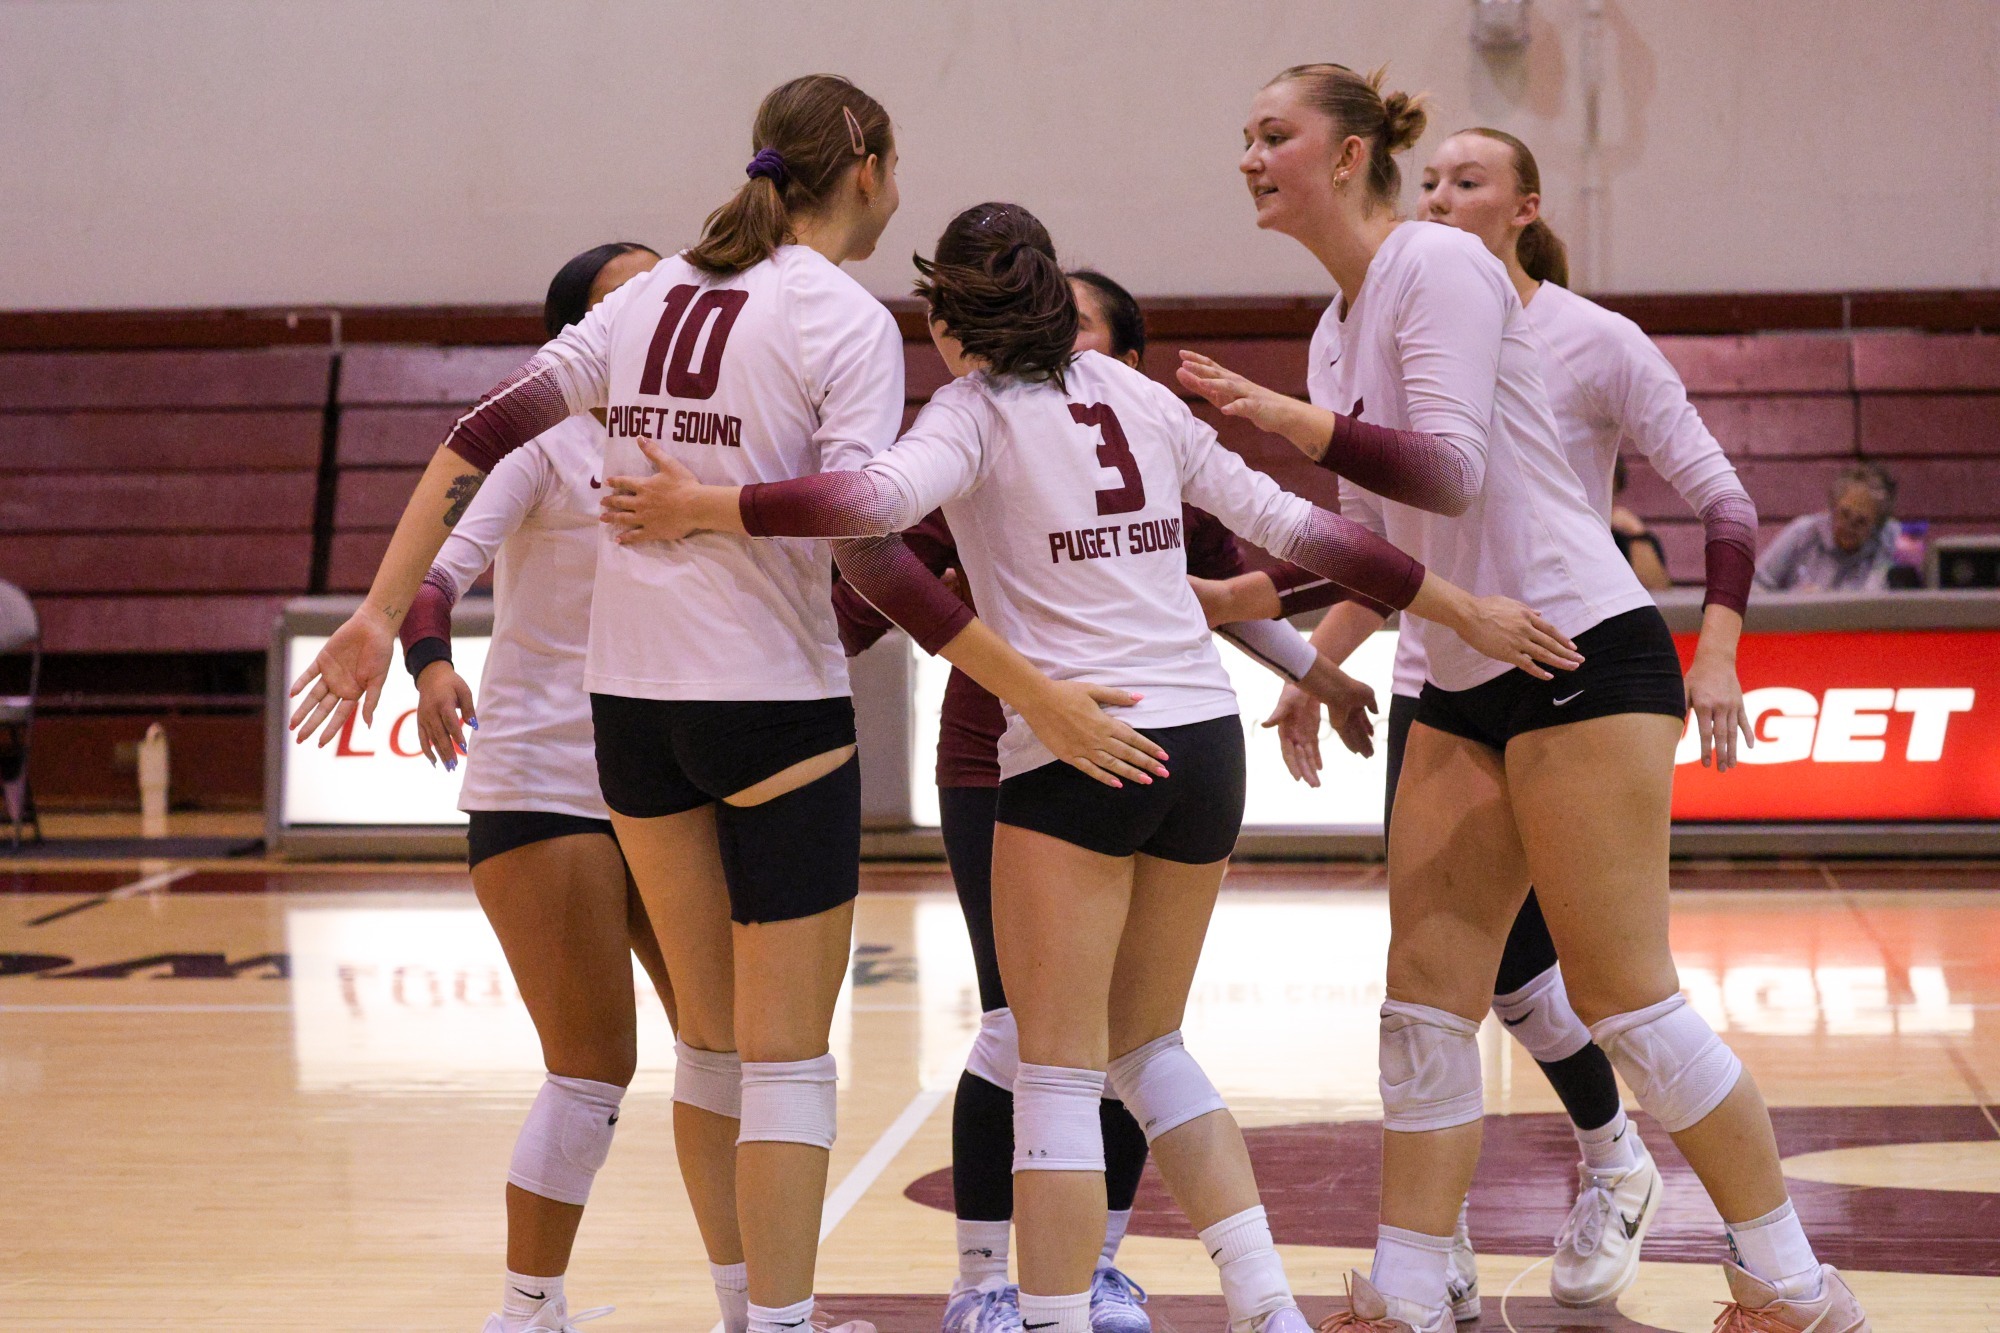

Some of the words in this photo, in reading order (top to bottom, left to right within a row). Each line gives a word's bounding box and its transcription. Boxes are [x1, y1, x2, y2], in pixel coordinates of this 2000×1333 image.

[639, 284, 749, 400] 10
[608, 405, 669, 440] PUGET
[672, 410, 742, 448] SOUND
[1067, 402, 1146, 516] 3
[1048, 526, 1121, 563] PUGET
[1128, 518, 1181, 555] SOUND
[1674, 686, 1976, 764] GET
